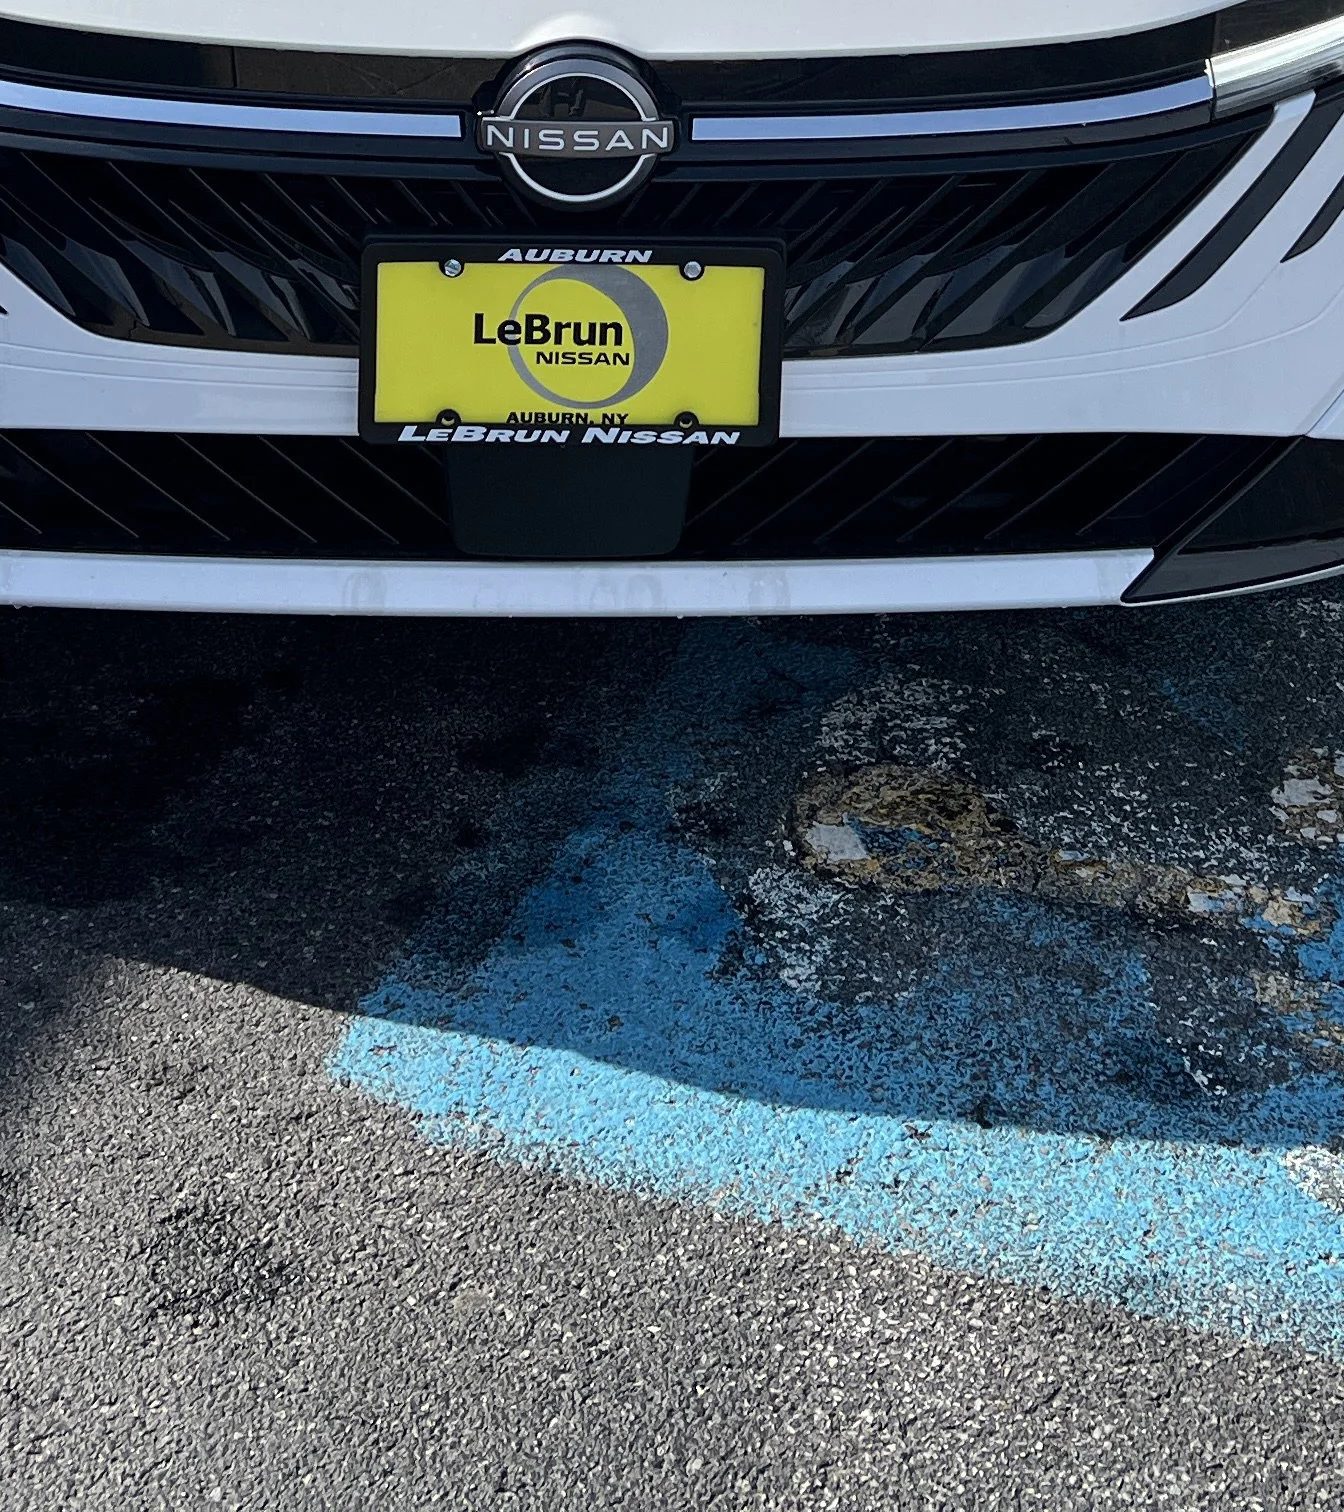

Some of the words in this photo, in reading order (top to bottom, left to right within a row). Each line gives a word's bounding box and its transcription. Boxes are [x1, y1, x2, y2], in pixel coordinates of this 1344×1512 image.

[486, 124, 669, 151] NISSAN
[498, 248, 653, 264] AUBURN
[473, 312, 623, 347] LeBrun
[535, 351, 631, 366] NISSAN
[601, 412, 630, 426] NY
